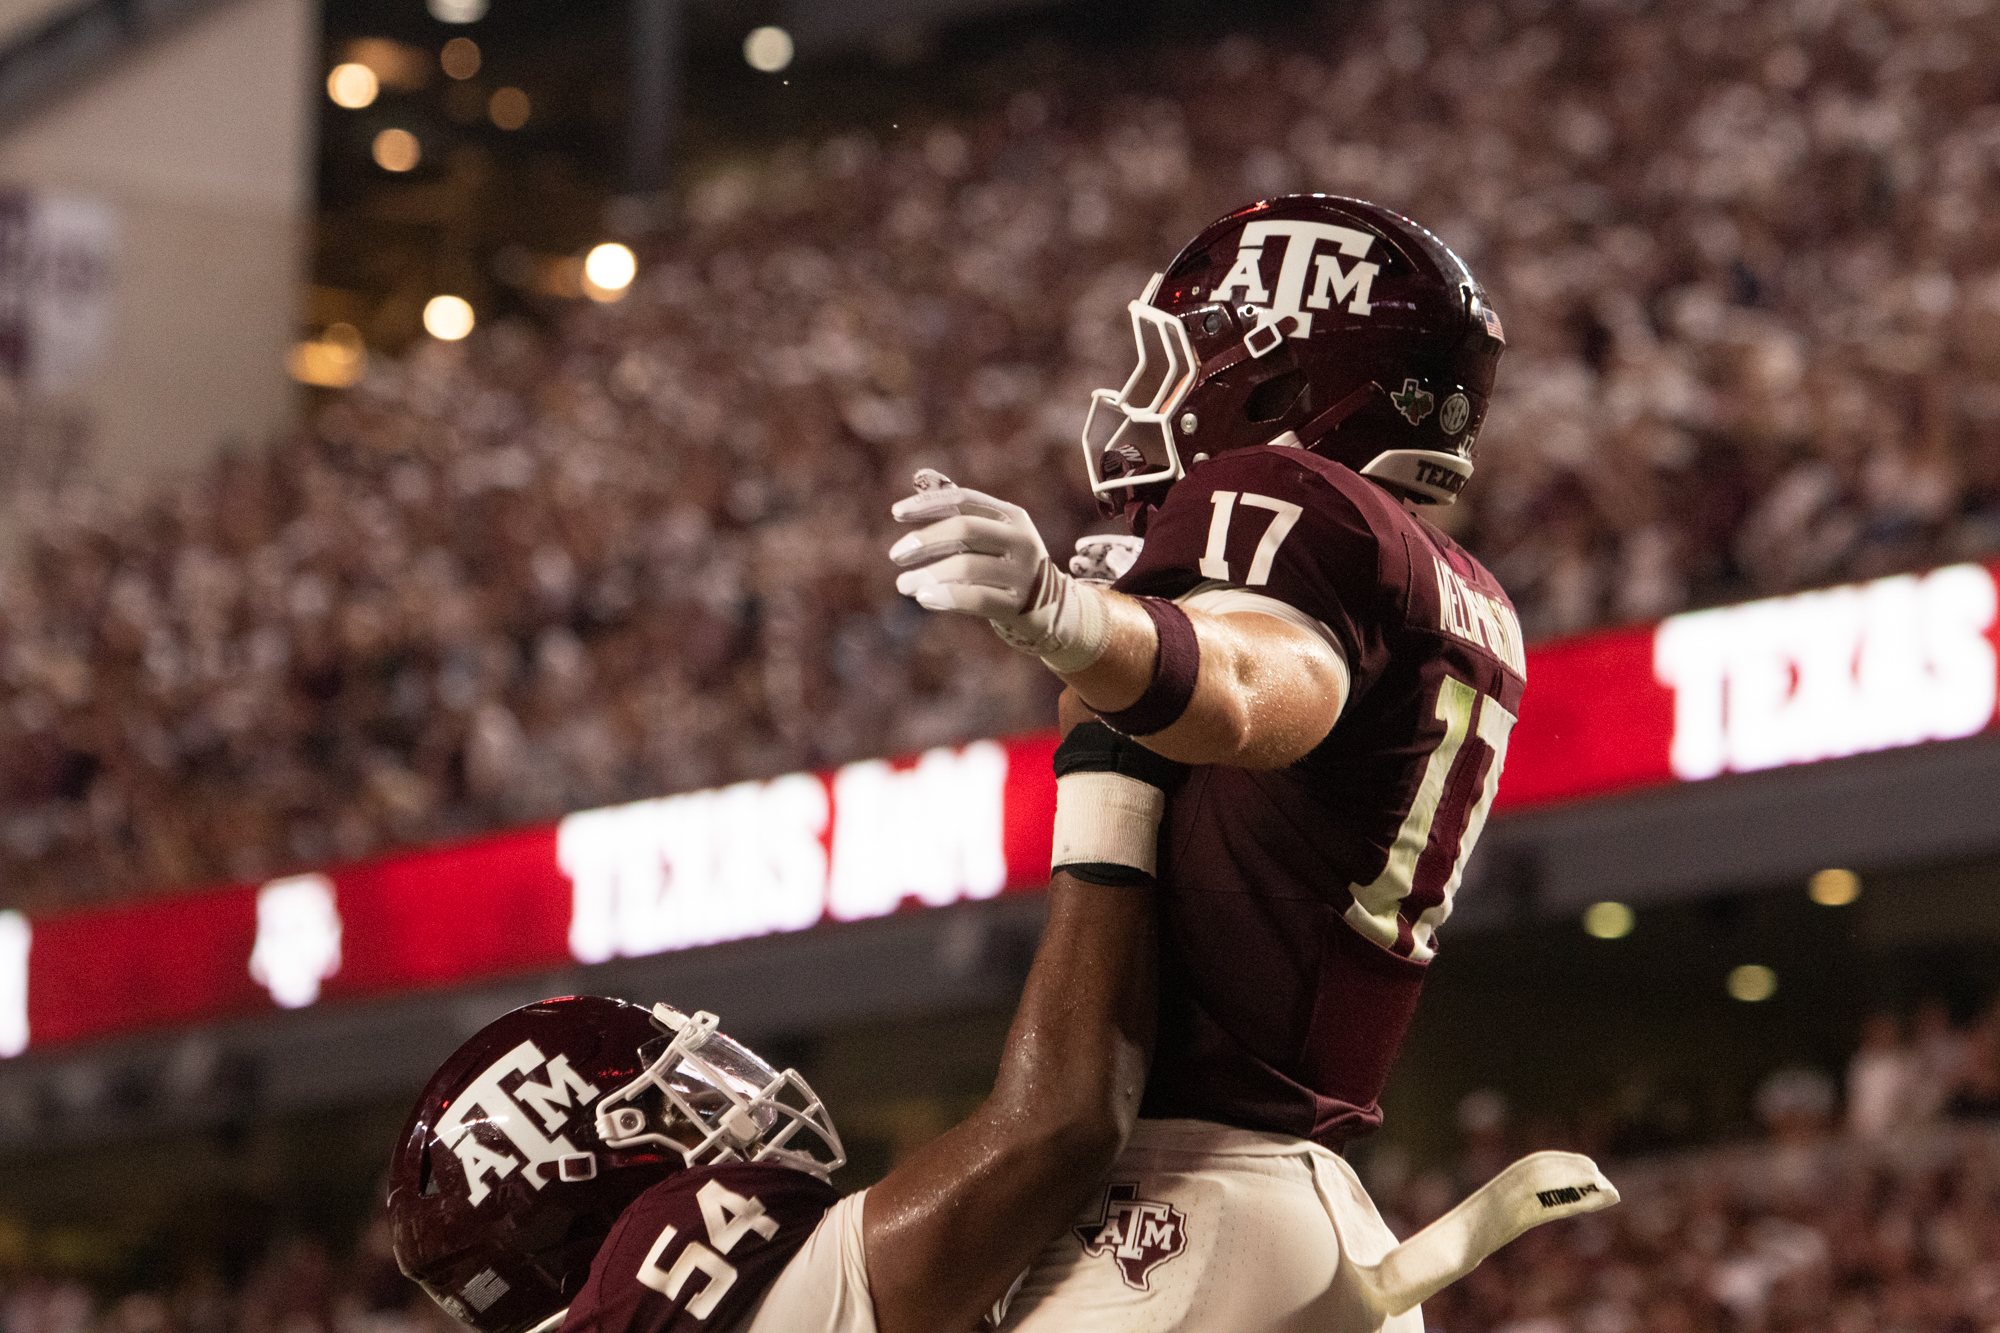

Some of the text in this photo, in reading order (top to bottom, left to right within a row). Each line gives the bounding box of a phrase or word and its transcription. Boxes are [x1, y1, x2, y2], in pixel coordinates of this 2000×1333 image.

[1199, 490, 1303, 586] 17
[1344, 674, 1518, 961] 17
[636, 1178, 780, 1321] 54
